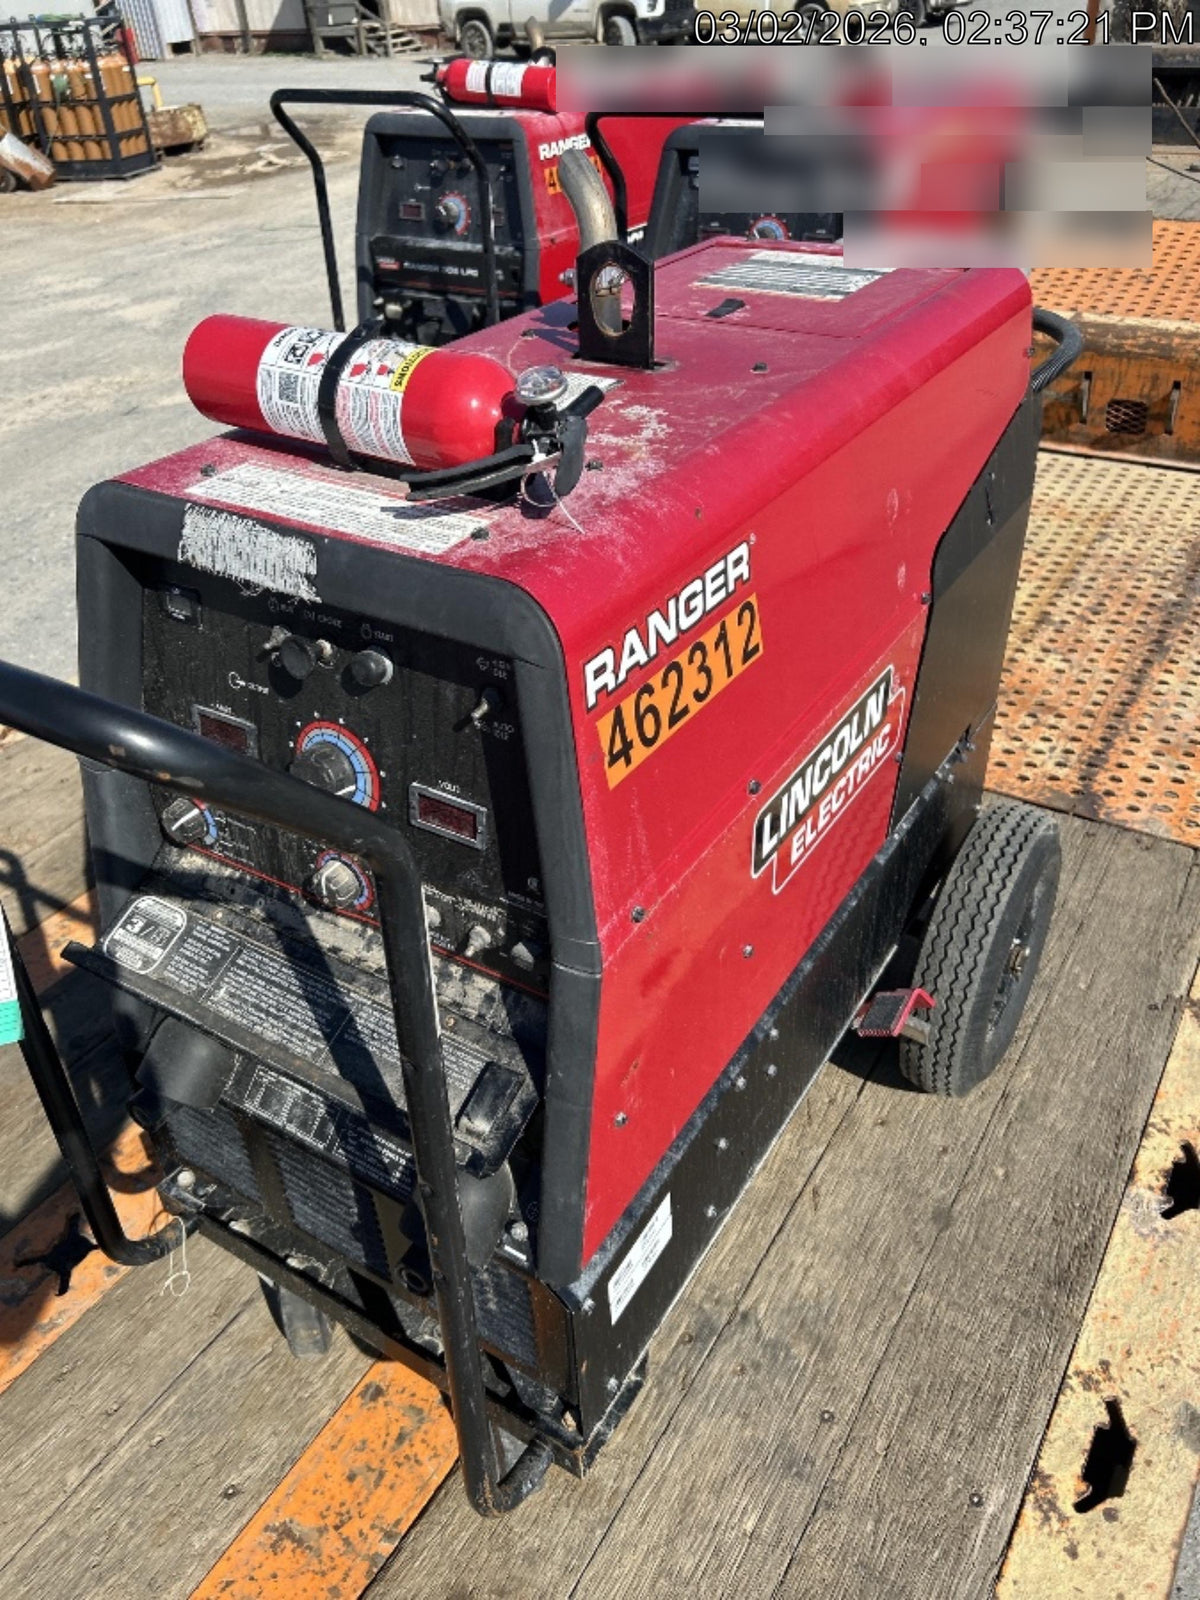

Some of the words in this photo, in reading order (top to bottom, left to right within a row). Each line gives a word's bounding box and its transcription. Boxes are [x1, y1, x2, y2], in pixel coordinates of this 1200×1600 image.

[538, 134, 591, 160] RANGE
[584, 541, 751, 710] RANGER
[607, 600, 761, 768] 462312
[760, 683, 890, 860] LINCOLN
[790, 724, 891, 866] ELECTRIC
